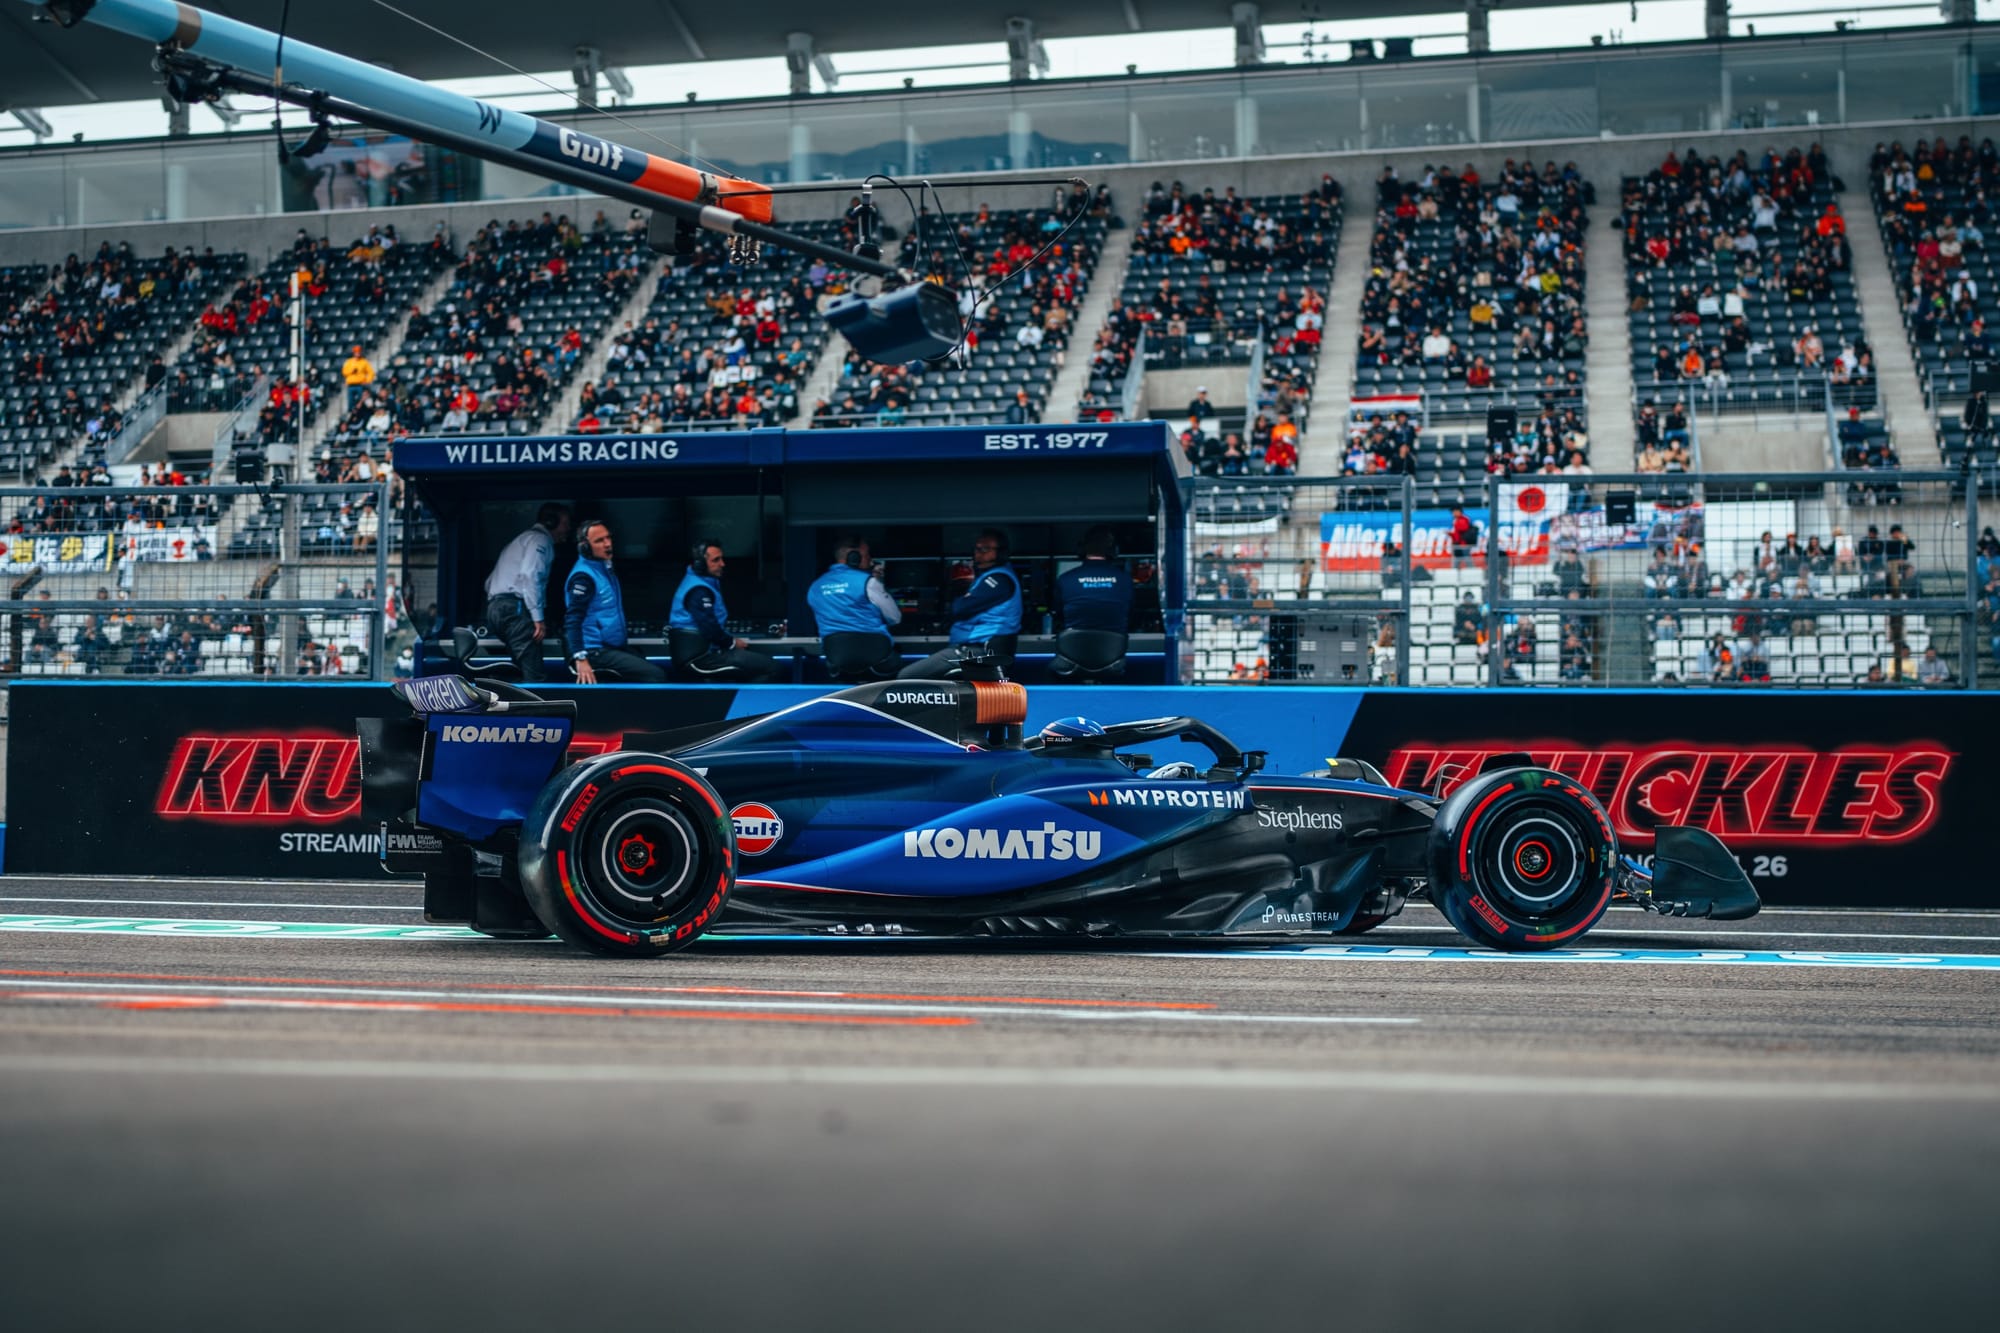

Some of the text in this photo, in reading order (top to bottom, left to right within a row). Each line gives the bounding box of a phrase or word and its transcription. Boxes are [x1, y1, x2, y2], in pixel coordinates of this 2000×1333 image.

[559, 127, 624, 171] Gulf
[445, 440, 679, 464] WILLIAMS RACING
[984, 432, 1109, 450] EST. 1977
[412, 677, 467, 712] kraken
[886, 692, 958, 705] DURACELL
[442, 723, 562, 743] KOMATSU
[561, 783, 599, 832] PIRELLI
[1113, 789, 1245, 809] MYPROTEIN
[1257, 805, 1342, 832] Stephens
[904, 822, 1101, 860] KOMATSU
[1752, 855, 1788, 877] 26
[1276, 912, 1340, 924] PURESTREAM
